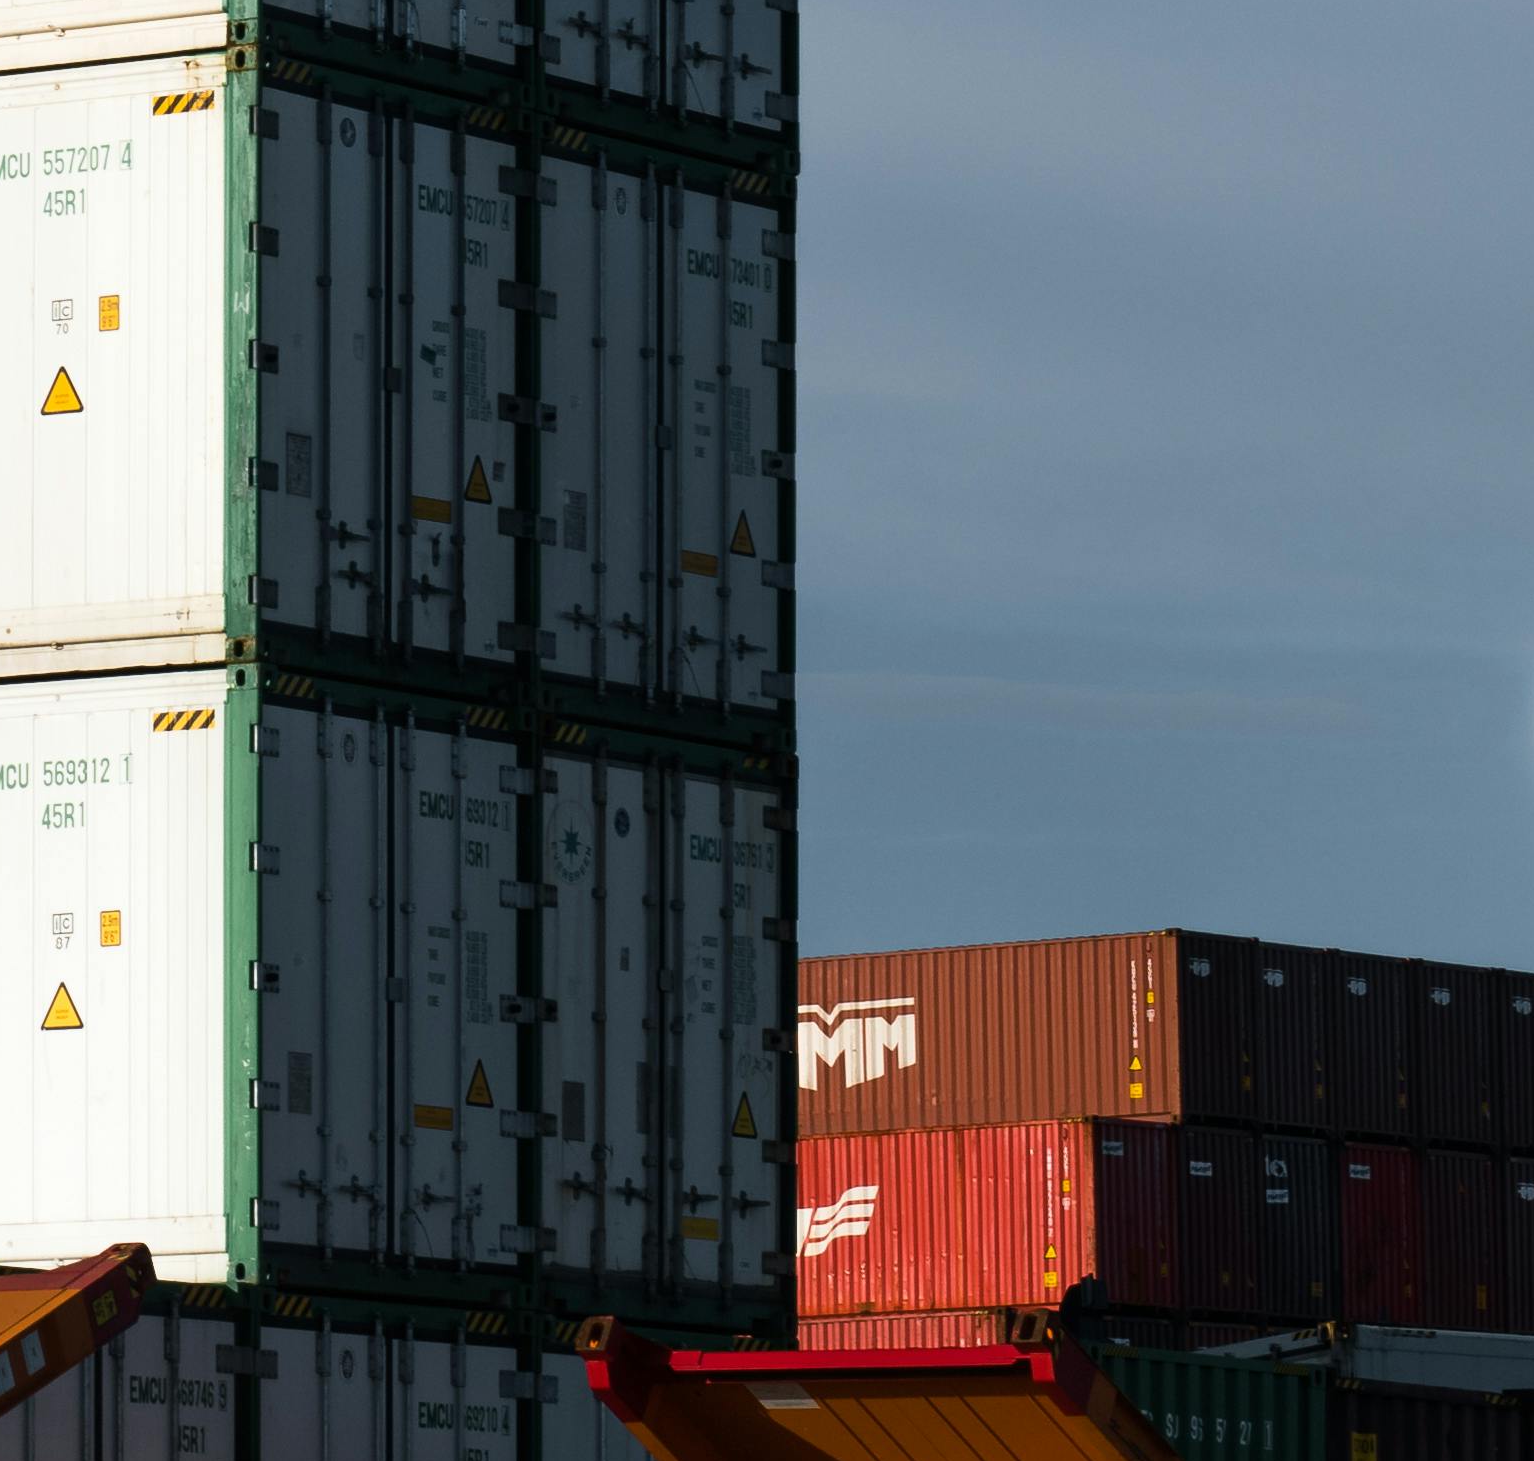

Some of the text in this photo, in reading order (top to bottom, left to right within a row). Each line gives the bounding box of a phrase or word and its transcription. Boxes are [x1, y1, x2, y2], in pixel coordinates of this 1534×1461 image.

[44, 145, 110, 175] 557207
[122, 143, 131, 167] 4
[43, 190, 85, 216] 45R1
[44, 759, 110, 786] 569312
[123, 757, 130, 782] 1
[42, 803, 85, 829] 45R1
[419, 1402, 453, 1428] EMCU
[466, 1406, 497, 1432] 69210
